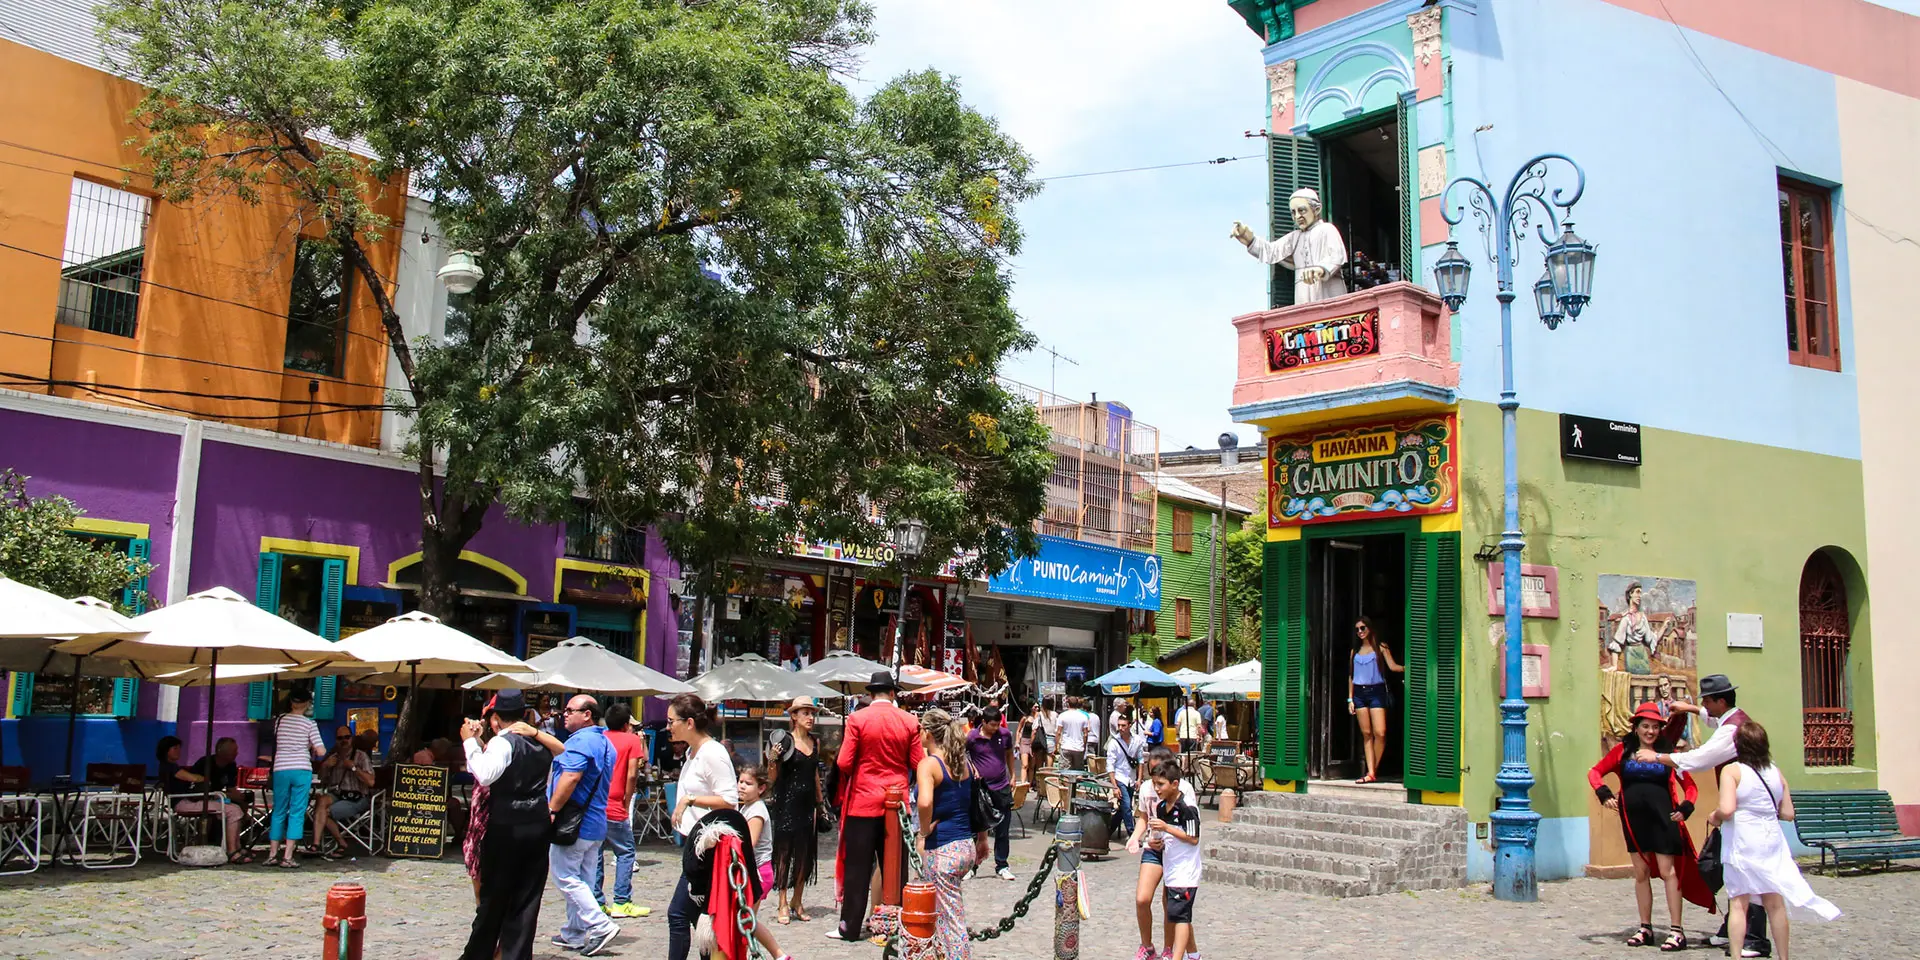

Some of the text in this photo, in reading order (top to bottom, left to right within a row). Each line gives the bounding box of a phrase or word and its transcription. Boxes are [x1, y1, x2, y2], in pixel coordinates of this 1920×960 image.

[1300, 342, 1348, 358] AMIGO
[1303, 352, 1344, 364] REGALOS
[1609, 422, 1638, 434] Caminito
[1319, 435, 1389, 458] HAVANNA
[1292, 450, 1423, 495] CAMINITO
[842, 542, 894, 562] WELCO
[1033, 556, 1128, 596] PUNTO Caminito
[1524, 578, 1544, 590] NITO
[1096, 586, 1116, 596] SHOPPING
[402, 768, 442, 778] CHOCOLATE
[418, 778, 442, 787] COÑAC
[395, 791, 444, 802] CHOCOLATE CON
[392, 800, 412, 809] CREMA
[416, 803, 446, 812] CARAMELO
[424, 818, 442, 826] LECHE
[398, 826, 430, 834] CROISSANT
[394, 834, 412, 843] DULCE
[421, 836, 438, 844] LECHE
